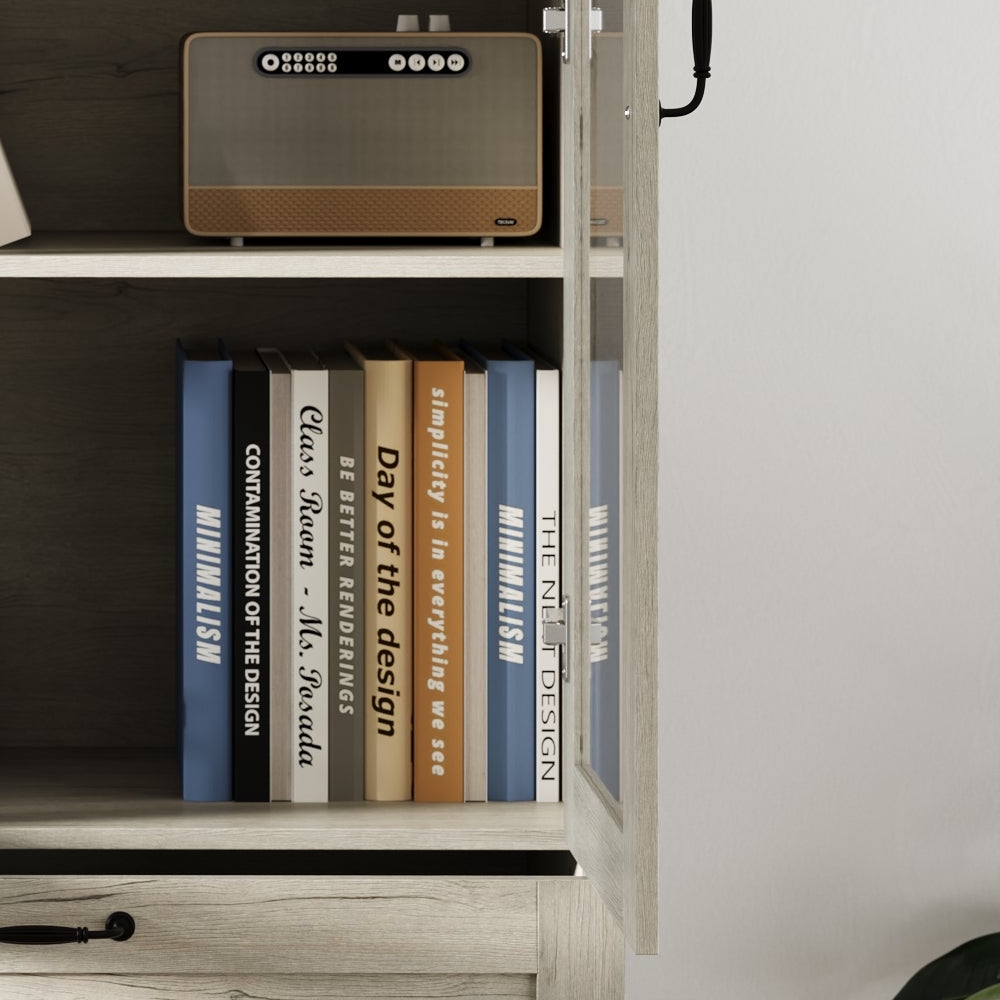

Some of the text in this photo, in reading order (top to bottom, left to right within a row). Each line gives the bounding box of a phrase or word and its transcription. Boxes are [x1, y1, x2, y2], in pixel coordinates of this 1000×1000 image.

[299, 405, 323, 477] Class
[196, 504, 221, 664] MINIMALISM
[244, 443, 261, 736] CONTAMINATION OF THE DESIGN
[299, 488, 322, 570] Room
[339, 456, 355, 715] BE BETTER RENDERINGS
[371, 446, 400, 738] Day of the design
[428, 388, 448, 776] simplicity is in everything we see
[499, 504, 523, 664] MINIMALISM
[299, 605, 322, 657] Ms.
[541, 510, 557, 781] THE NT DESIGN
[299, 666, 321, 768] Posada
